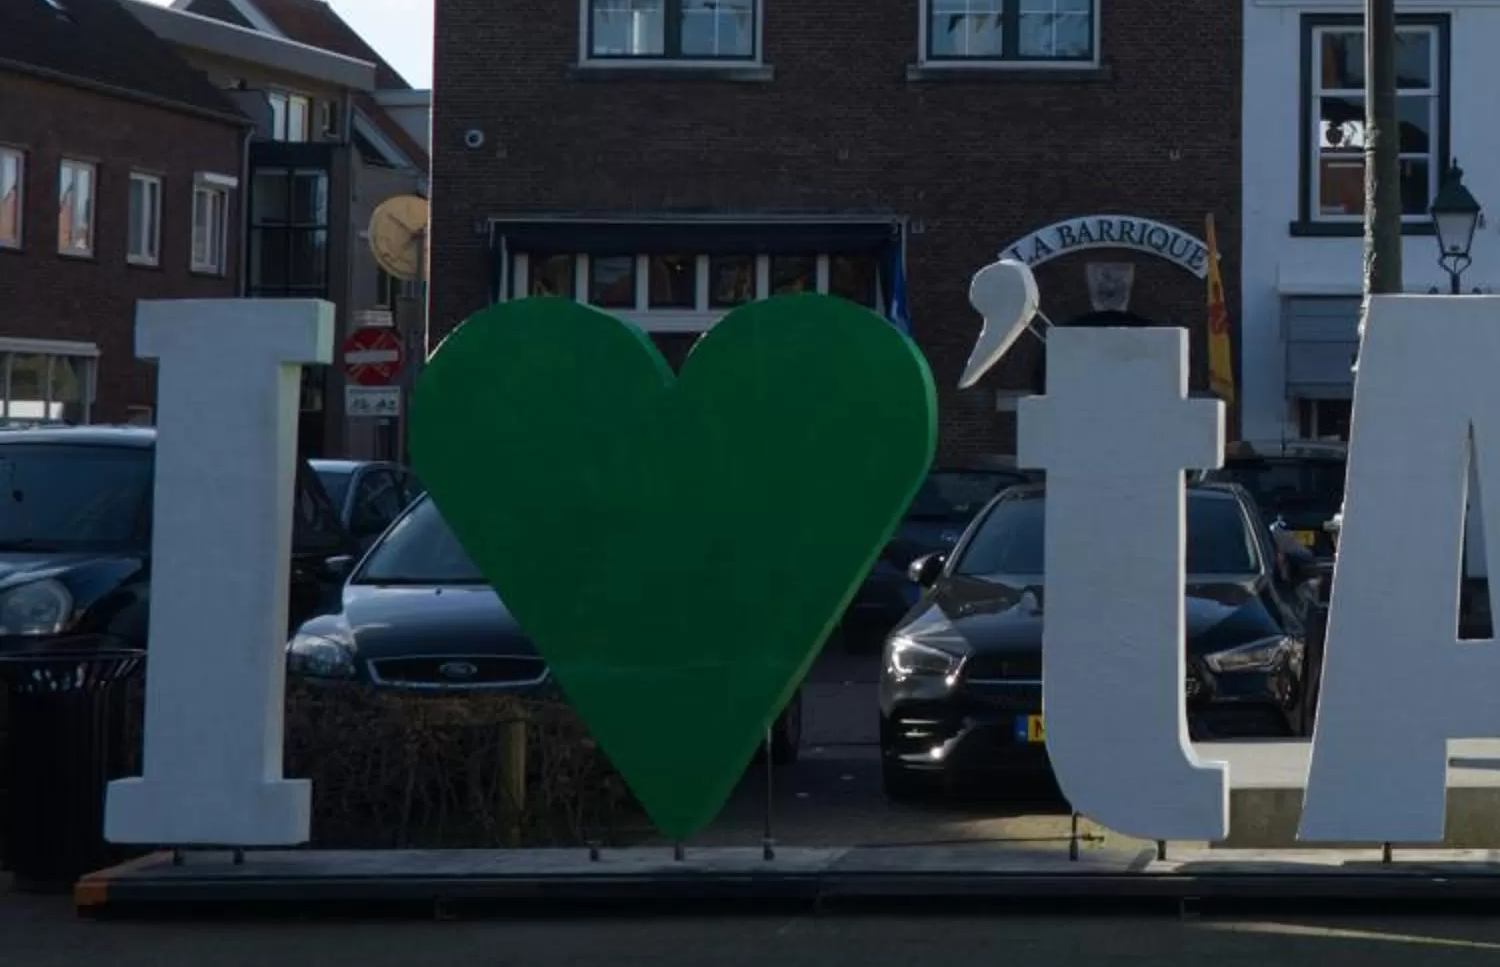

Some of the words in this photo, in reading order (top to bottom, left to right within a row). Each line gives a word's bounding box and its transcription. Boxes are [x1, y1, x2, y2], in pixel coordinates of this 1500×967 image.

[1010, 236, 1054, 265] LA
[1055, 218, 1210, 271] BARRIQUE
[104, 298, 336, 846] I
